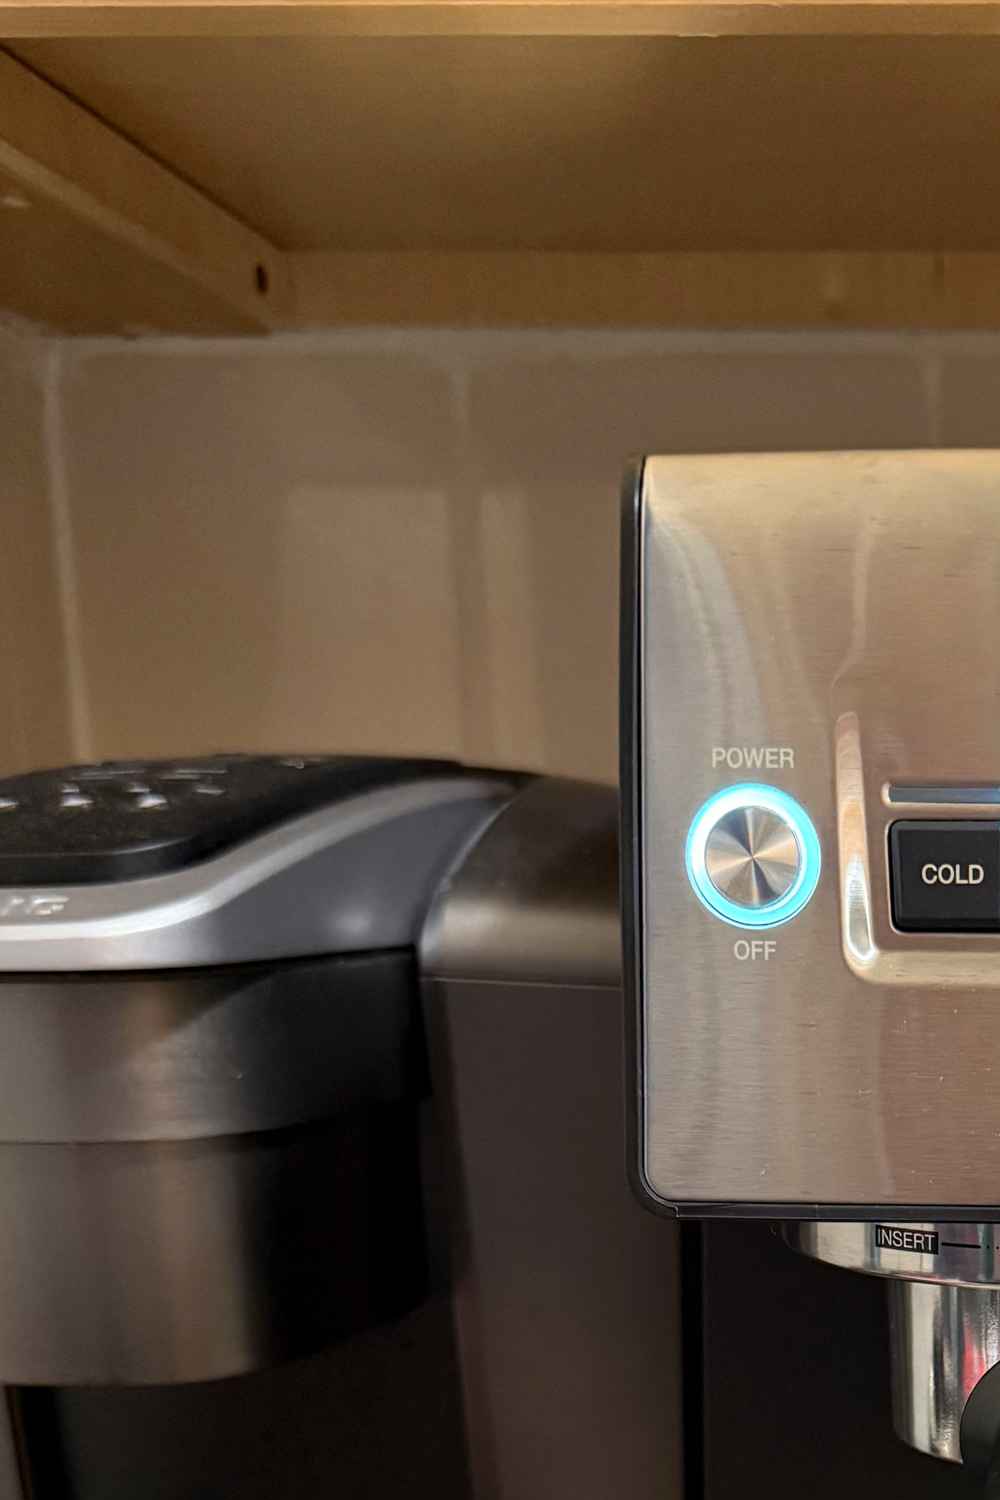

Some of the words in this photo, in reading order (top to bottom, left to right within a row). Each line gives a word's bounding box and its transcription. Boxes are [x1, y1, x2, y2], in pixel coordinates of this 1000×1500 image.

[711, 748, 795, 769] POWER
[921, 863, 985, 886] COLD
[733, 940, 777, 961] OFF
[877, 1228, 935, 1250] INSERT
